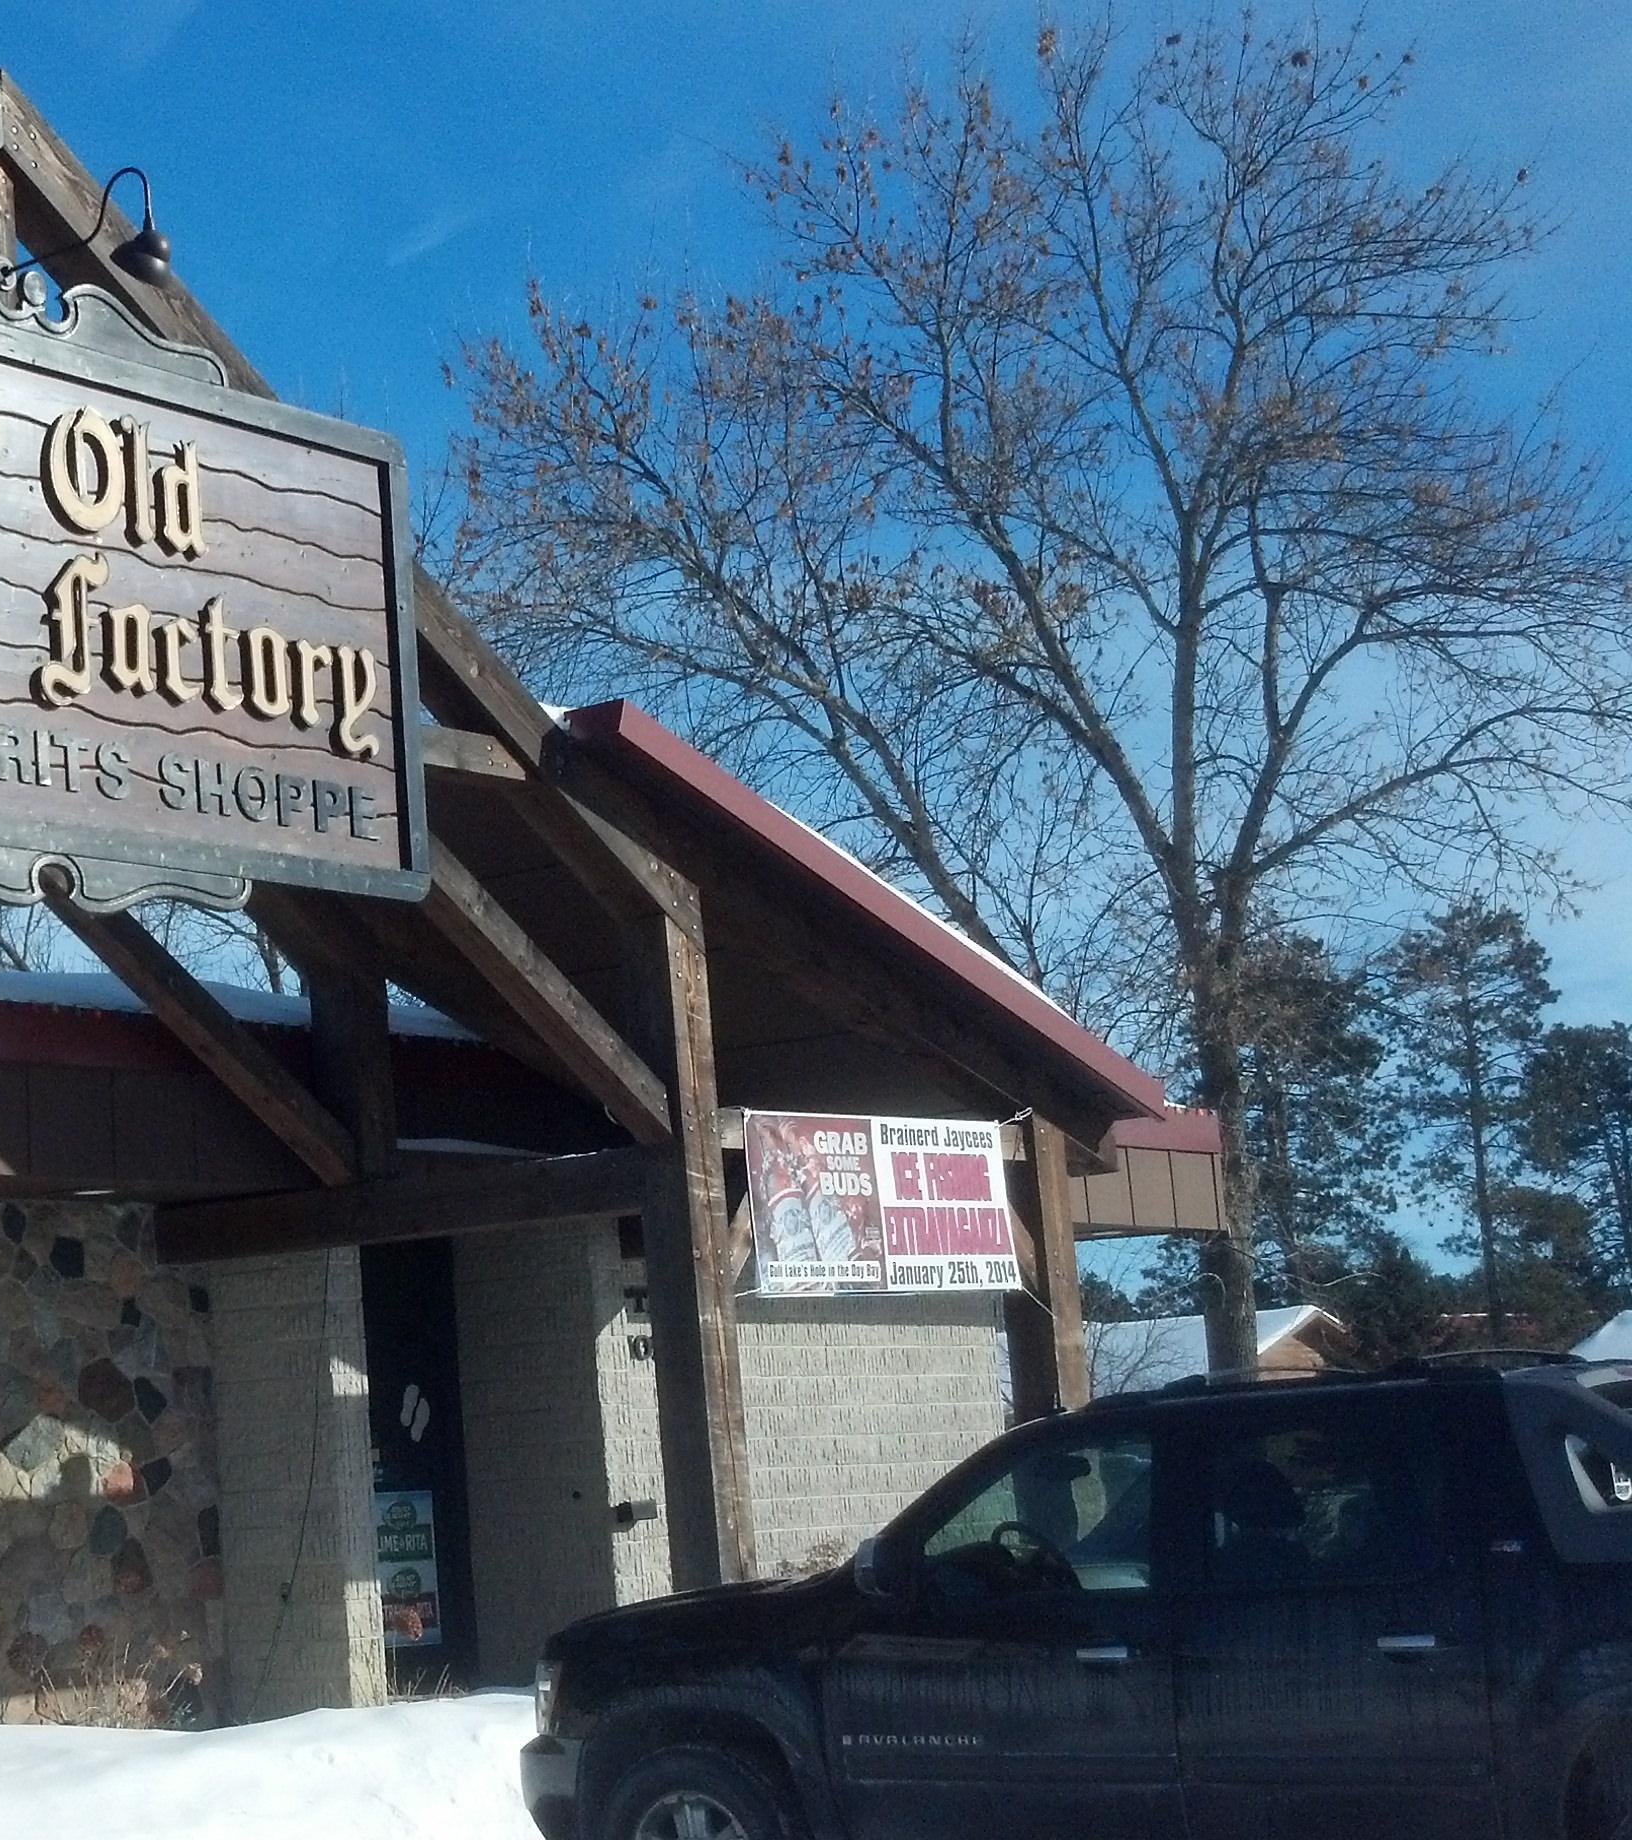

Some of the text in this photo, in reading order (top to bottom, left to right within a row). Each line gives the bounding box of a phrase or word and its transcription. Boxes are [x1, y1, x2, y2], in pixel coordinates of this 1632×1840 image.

[41, 404, 210, 559] Old
[31, 551, 381, 759] Factory
[156, 752, 383, 842] SHOPPE
[813, 1130, 868, 1155] GRAB
[879, 1123, 993, 1151] Brainerd Jaycees
[826, 1155, 861, 1171] SOME
[890, 1152, 923, 1201] ICE
[819, 1171, 873, 1196] BUDS
[785, 1264, 809, 1278] Lake's
[837, 1264, 850, 1277] the
[890, 1260, 1017, 1288] January 25th, 2014
